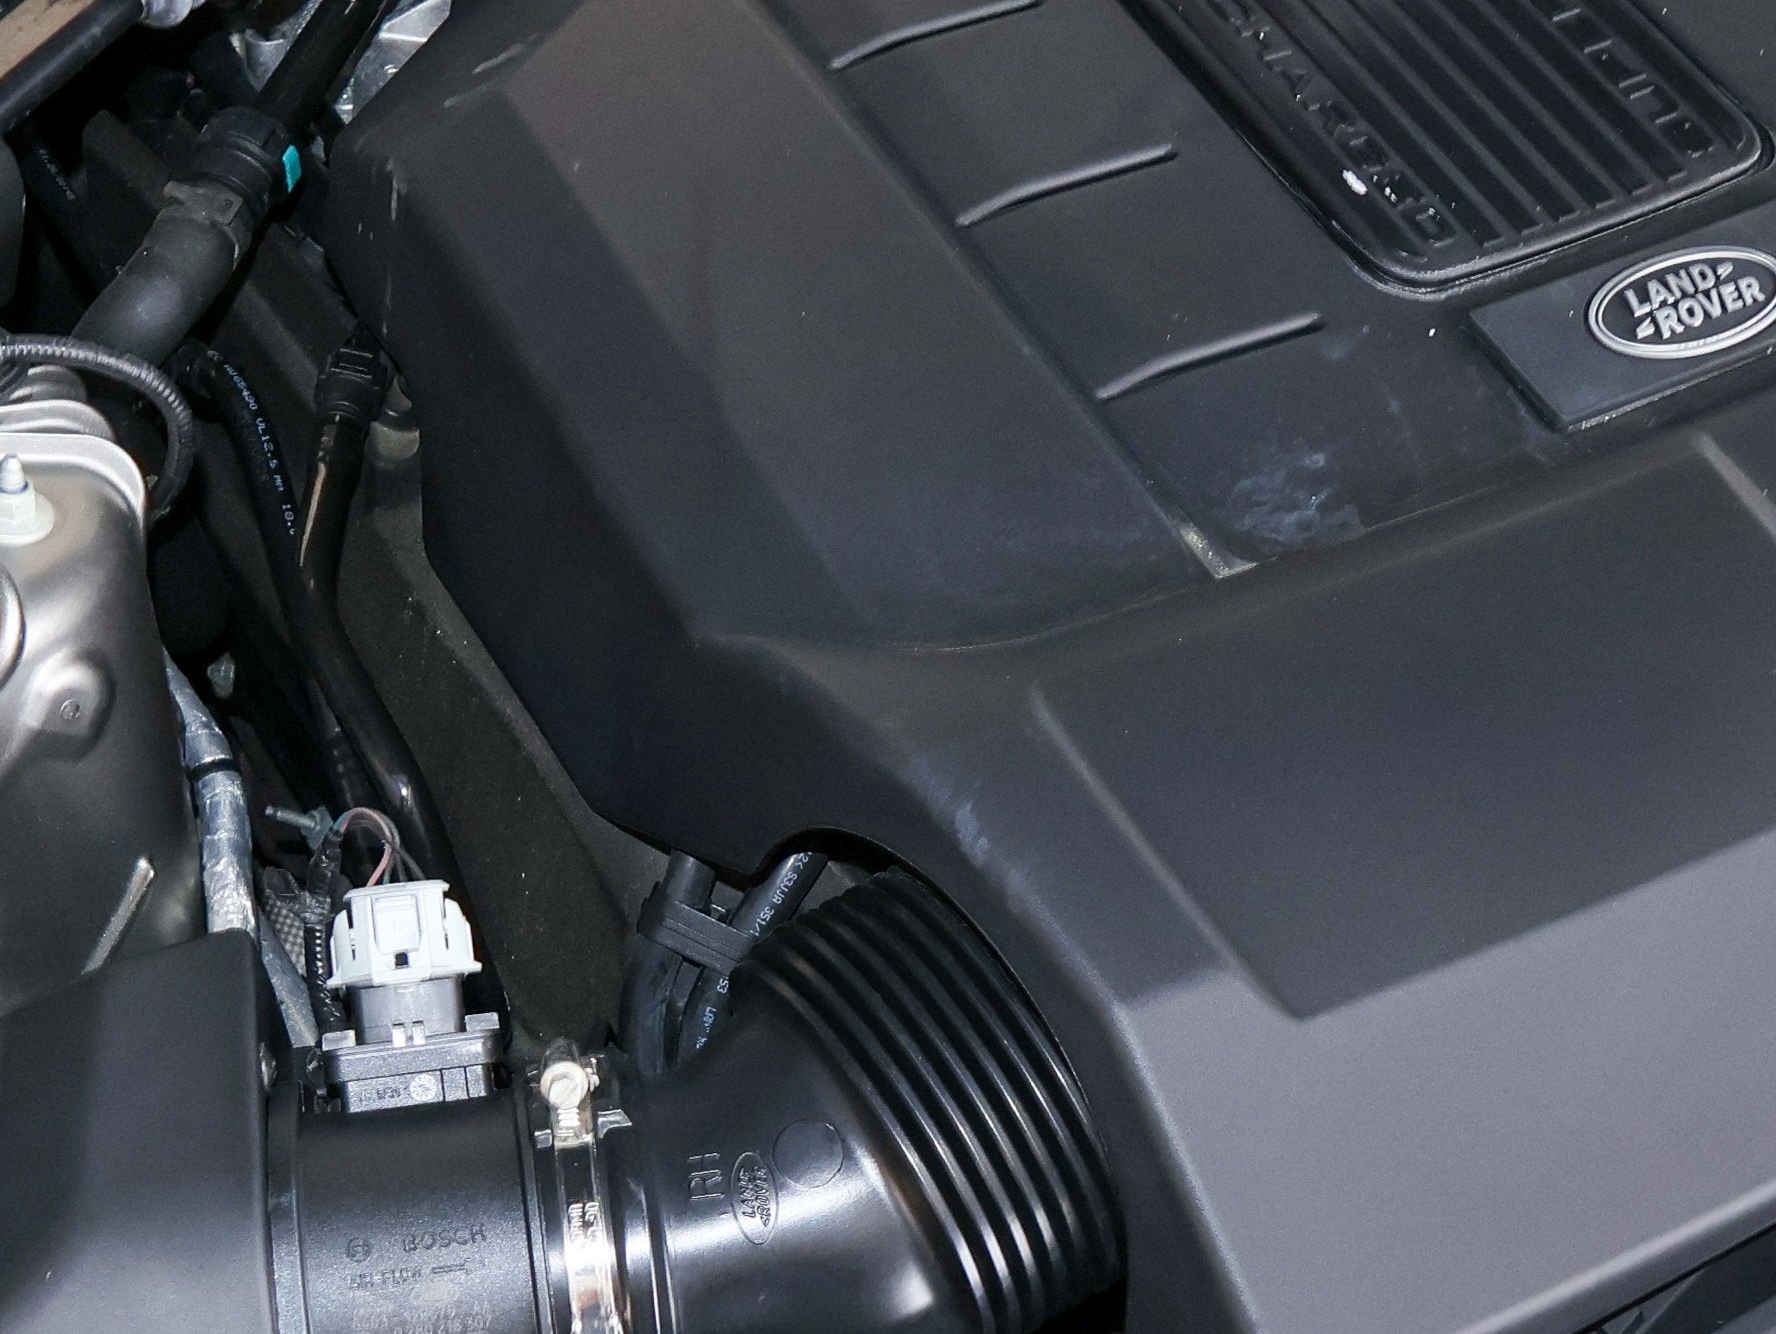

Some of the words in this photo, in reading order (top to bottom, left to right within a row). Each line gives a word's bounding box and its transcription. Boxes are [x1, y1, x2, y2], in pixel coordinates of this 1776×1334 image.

[1623, 262, 1719, 318] LAND
[1652, 274, 1766, 340] ROVER
[686, 1153, 725, 1200] RH
[402, 1225, 487, 1254] BOSCH
